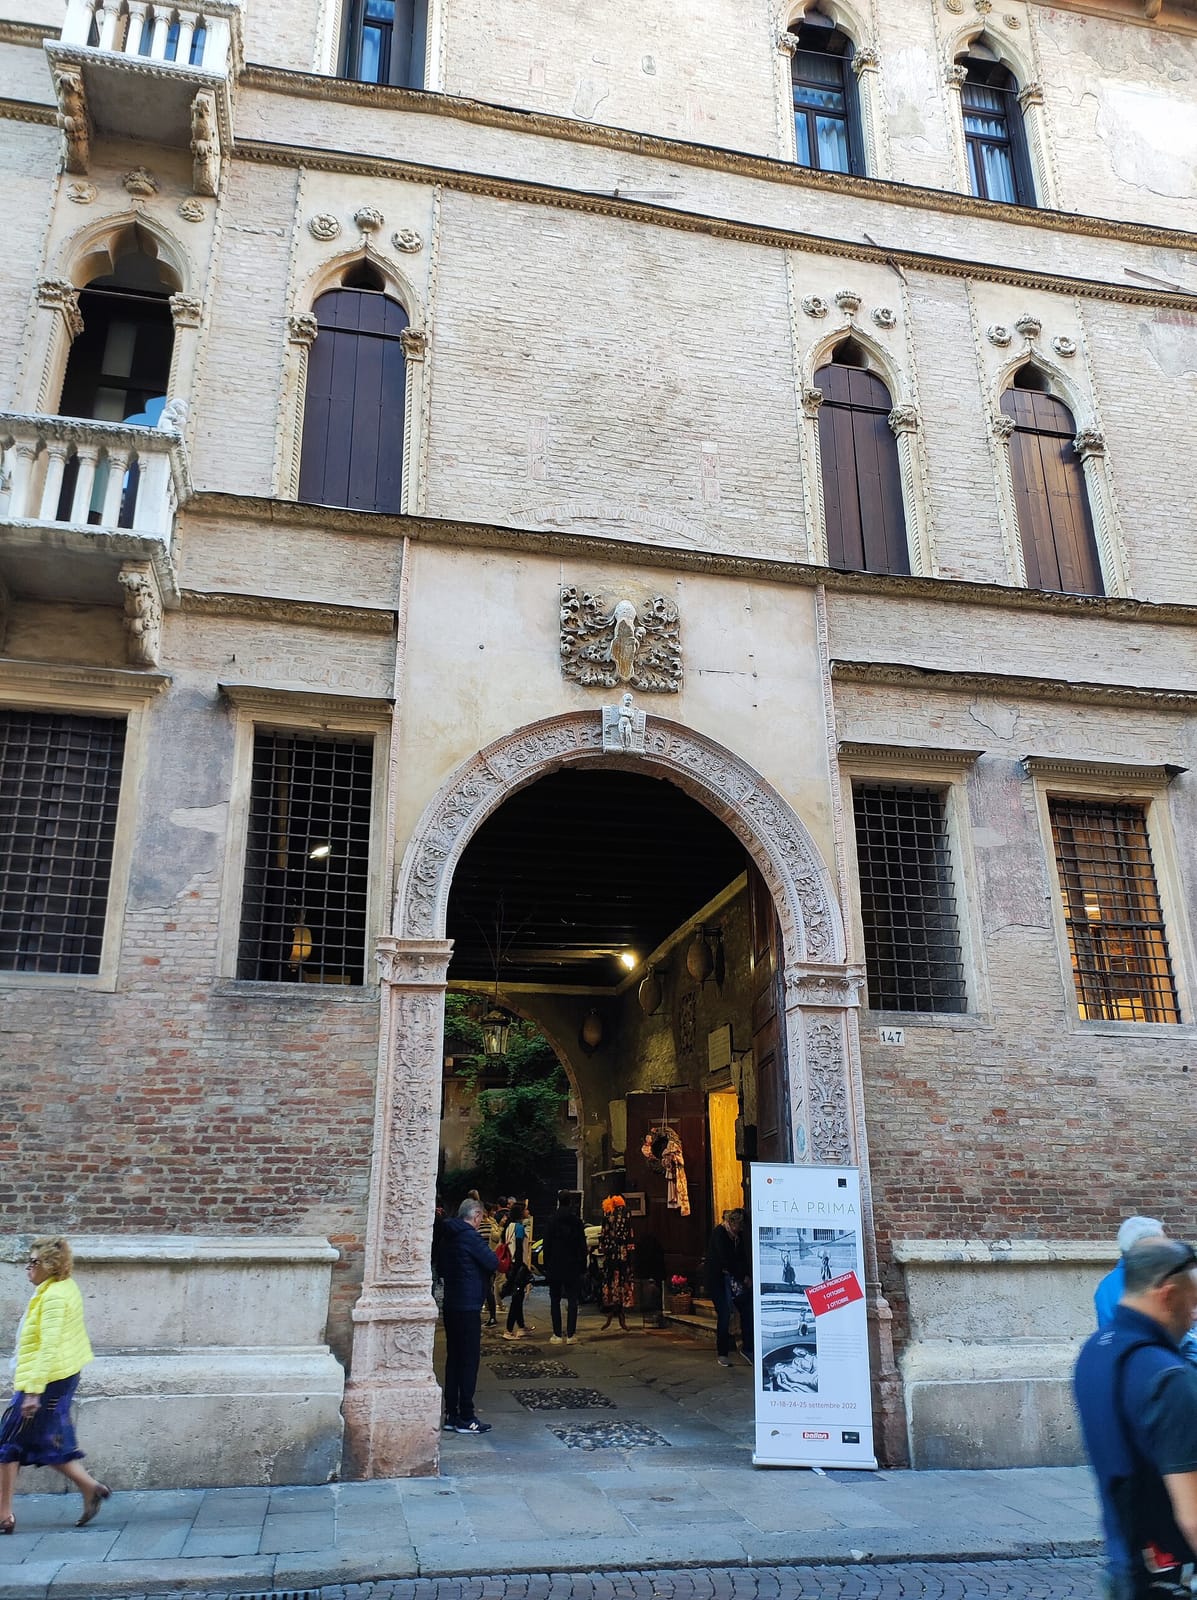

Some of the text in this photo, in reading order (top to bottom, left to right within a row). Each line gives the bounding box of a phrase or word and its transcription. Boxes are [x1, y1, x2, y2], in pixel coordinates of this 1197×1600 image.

[881, 1031, 902, 1042] 147
[757, 1198, 856, 1215] L'ETÀ PRIMA
[826, 1287, 845, 1299] OTTOBRE
[830, 1296, 849, 1308] OTTOBRE
[841, 1402, 857, 1410] 2022
